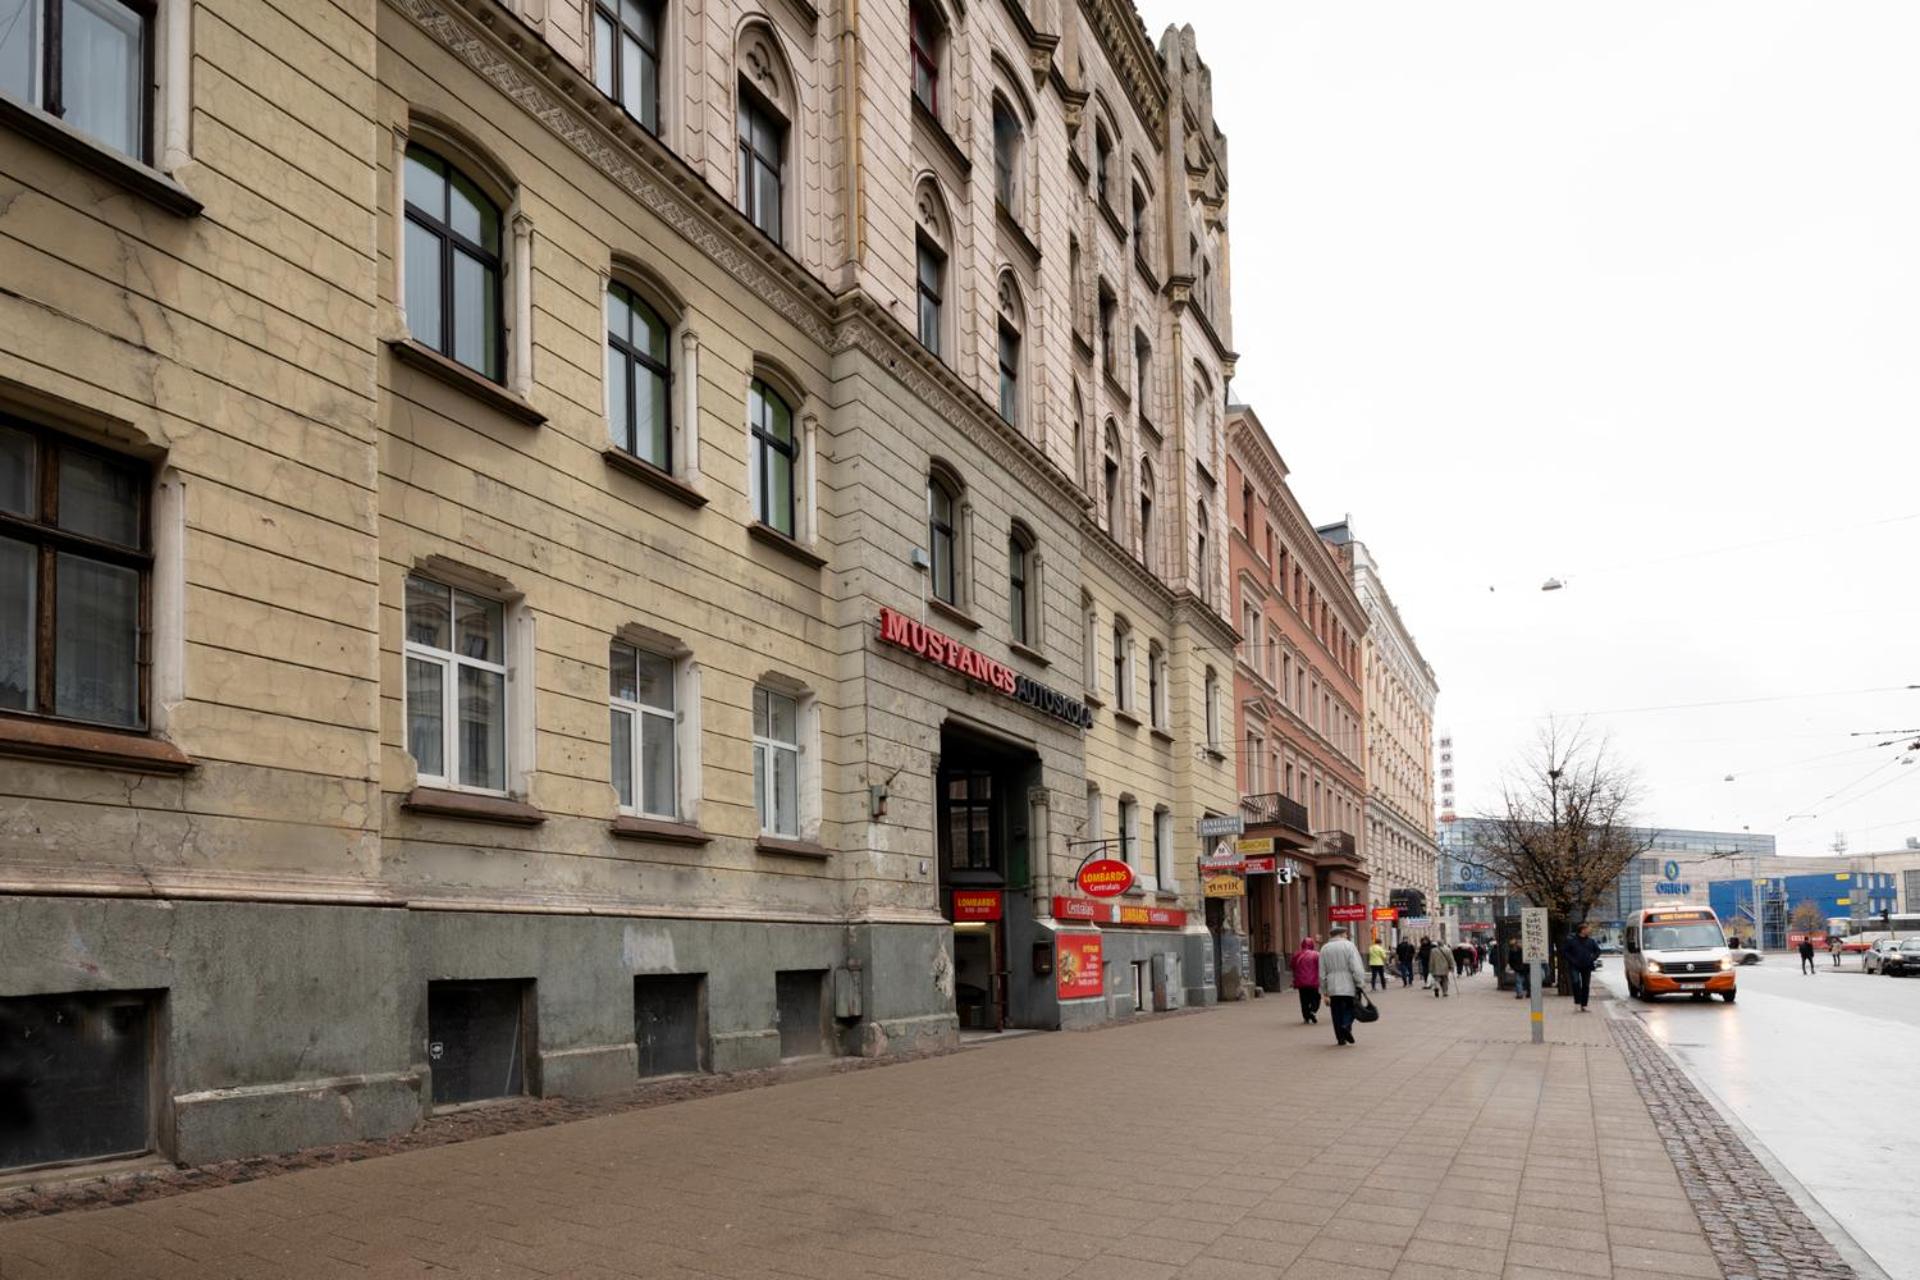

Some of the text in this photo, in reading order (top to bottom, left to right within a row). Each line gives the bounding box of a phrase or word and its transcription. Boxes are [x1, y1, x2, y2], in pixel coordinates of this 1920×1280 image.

[879, 607, 1093, 729] MUSTANGS AUTOSKOLA
[1440, 738, 1453, 808] HOTEL
[1082, 870, 1127, 884] LOMBARDS
[1656, 881, 1691, 895] ORIGO
[957, 897, 996, 907] LOMBARDS
